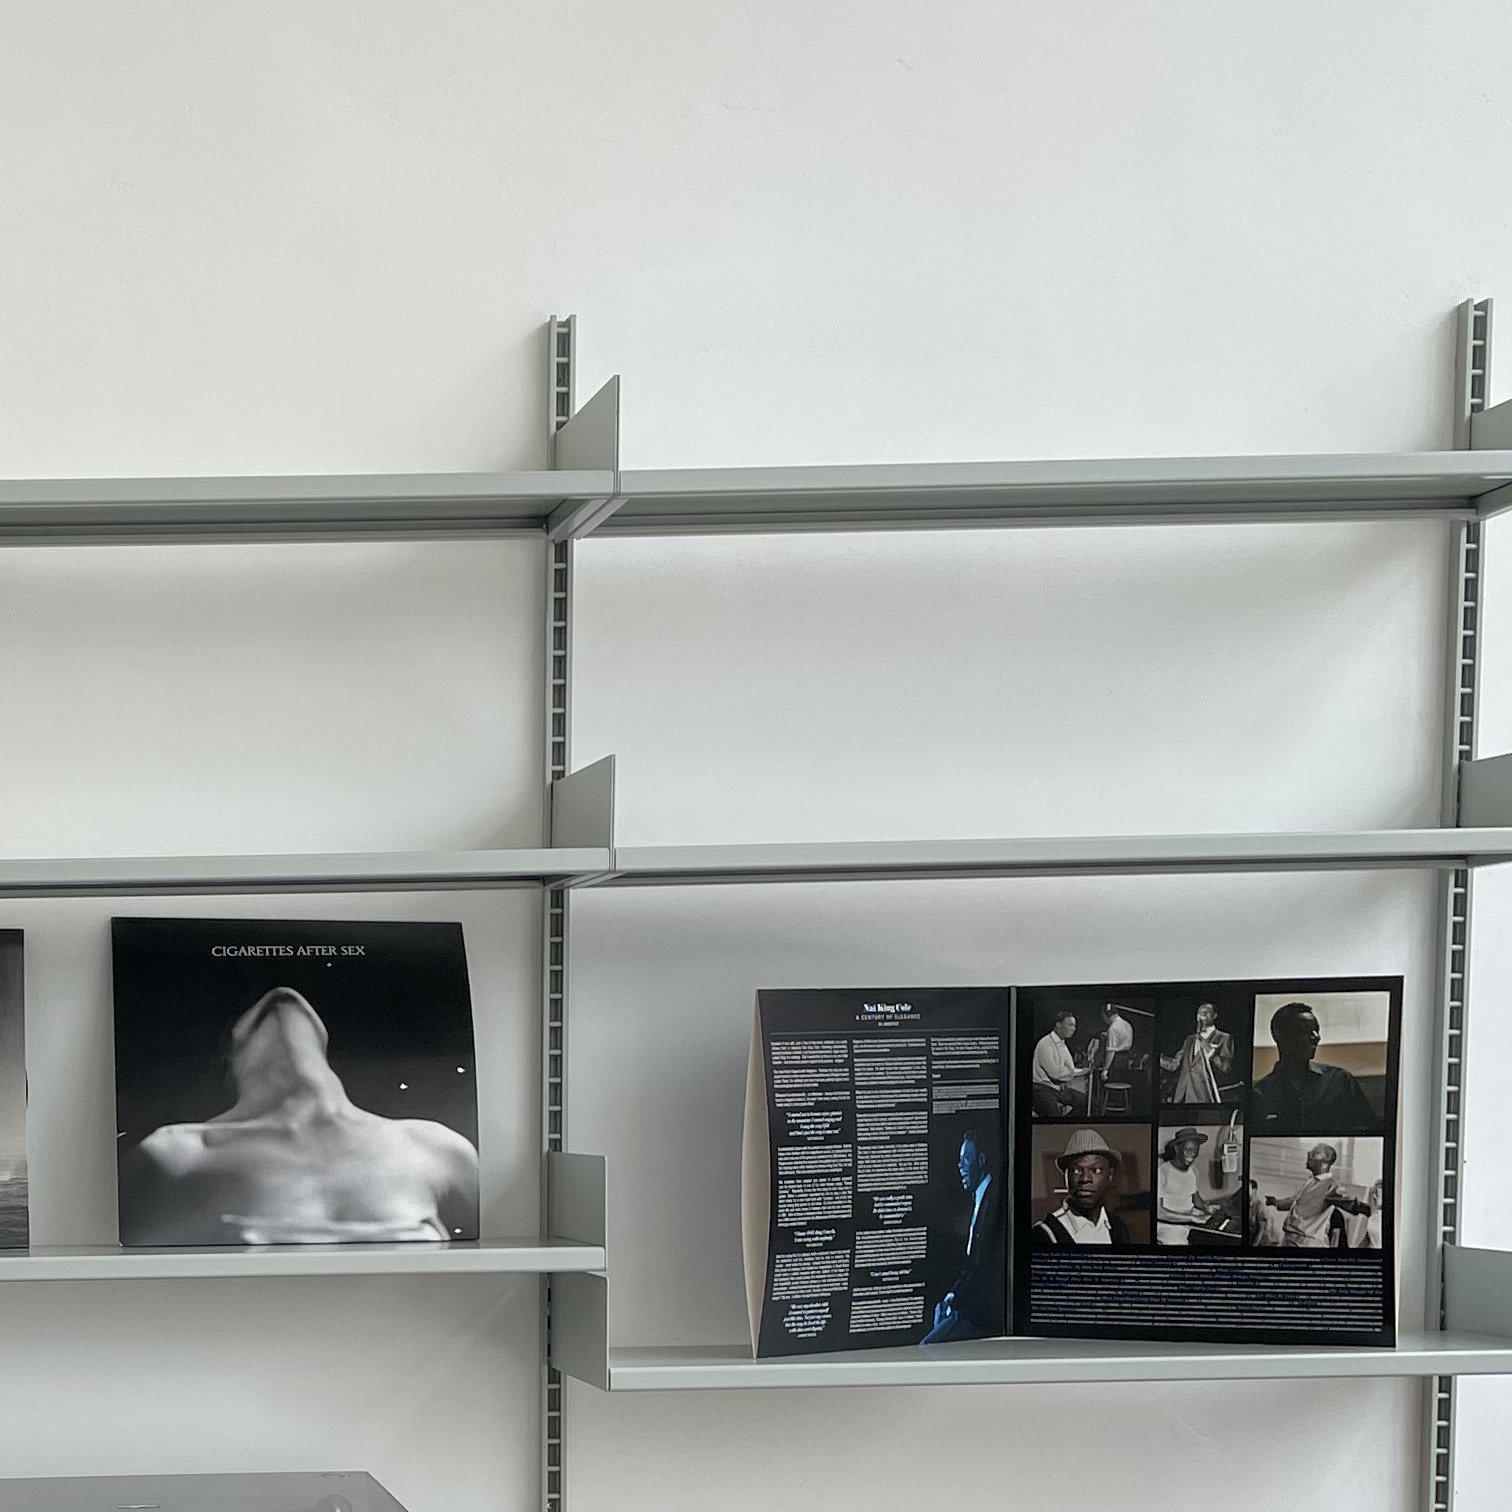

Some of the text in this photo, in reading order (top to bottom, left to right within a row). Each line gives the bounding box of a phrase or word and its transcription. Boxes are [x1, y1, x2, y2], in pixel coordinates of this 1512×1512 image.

[211, 946, 365, 957] CIGARETTES AFTER SEX
